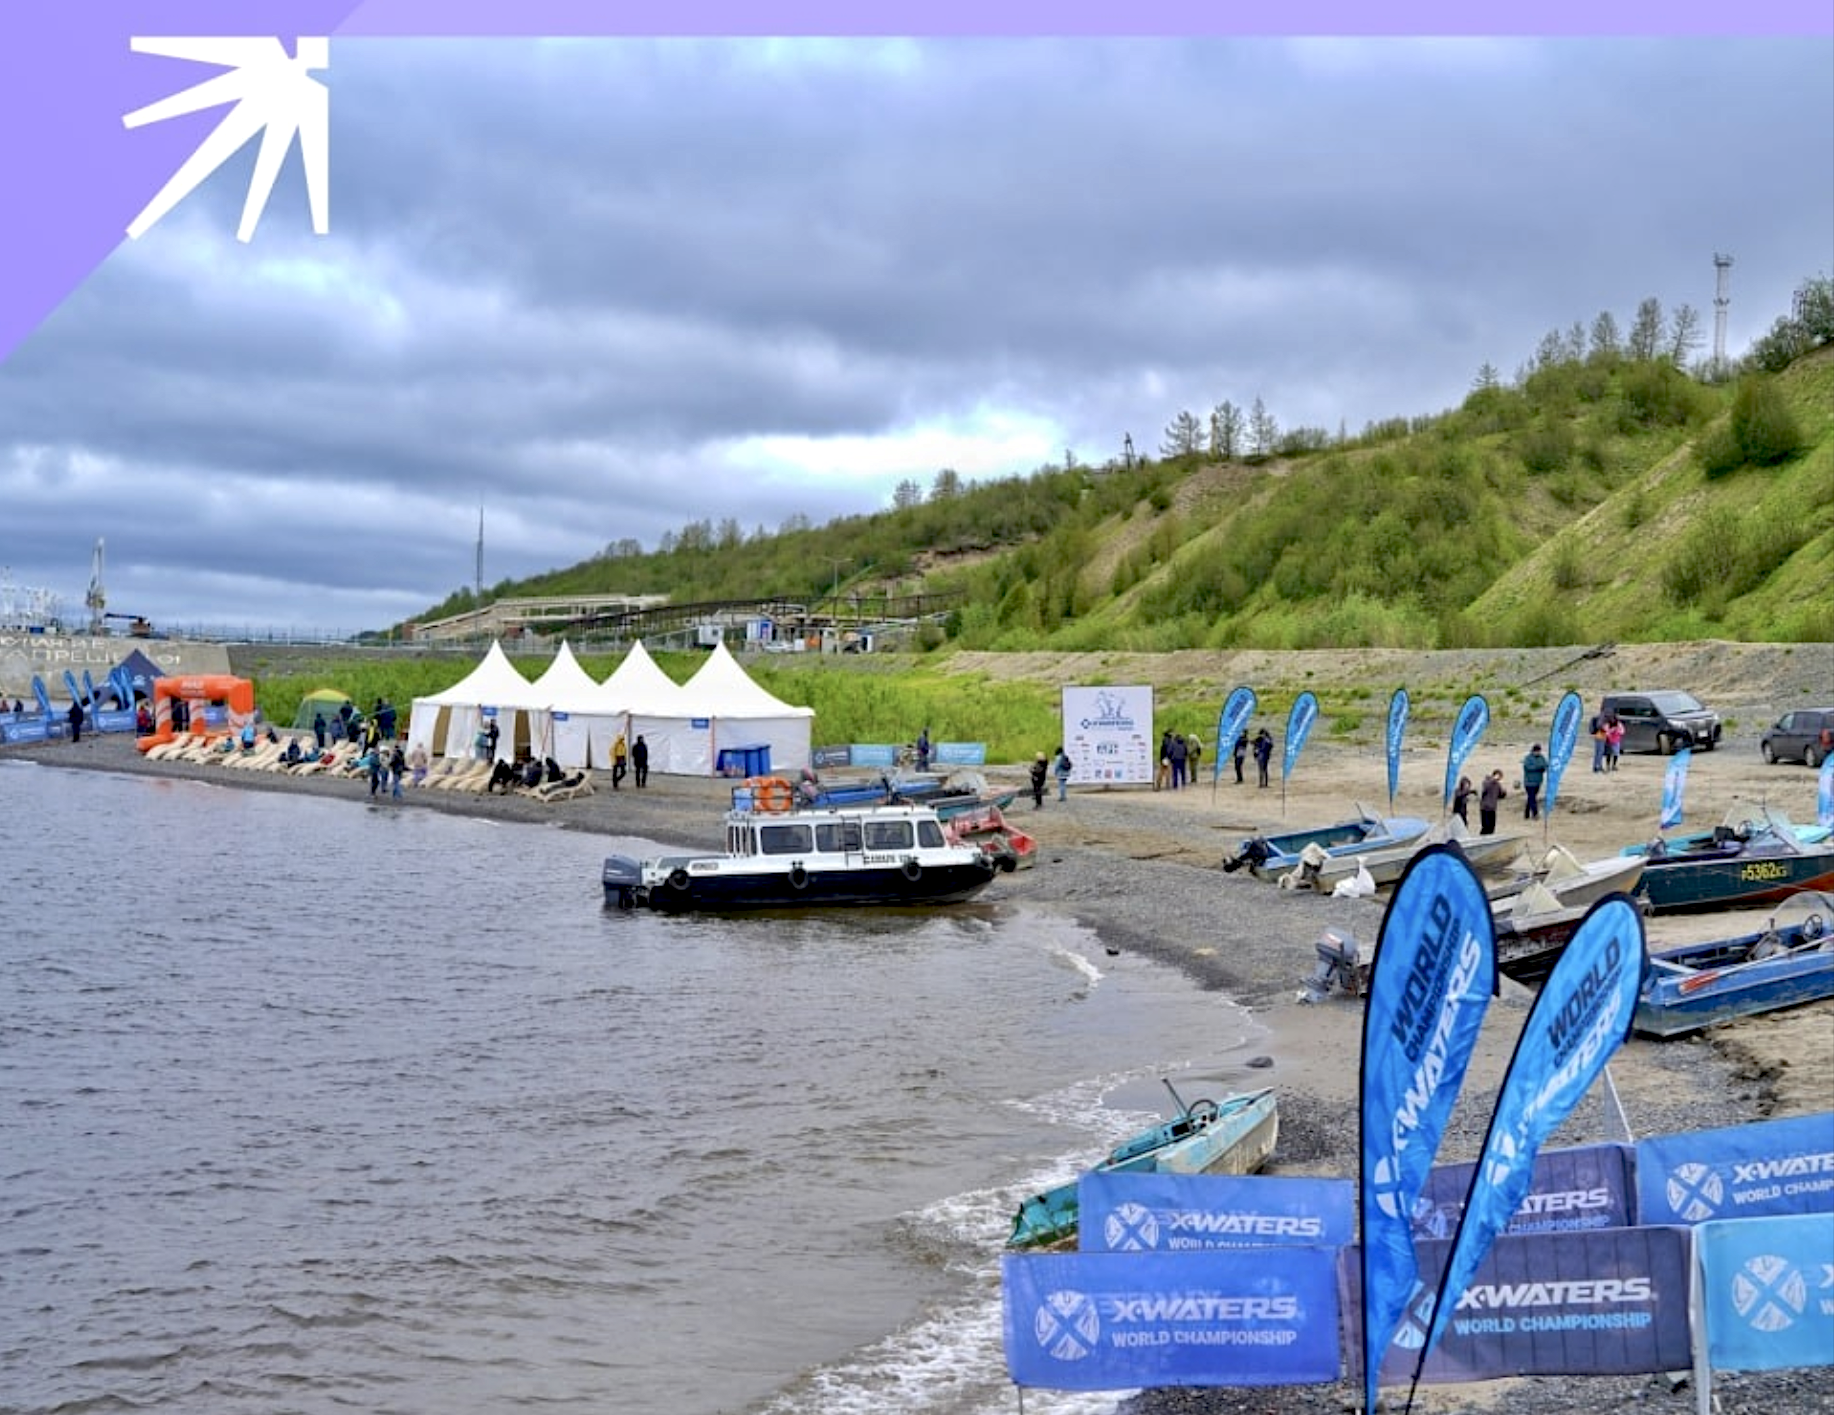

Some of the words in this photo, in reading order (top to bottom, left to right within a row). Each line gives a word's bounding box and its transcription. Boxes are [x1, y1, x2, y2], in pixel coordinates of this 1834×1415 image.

[1390, 893, 1452, 1046] WORLD
[1548, 936, 1621, 1049] WORLD
[1731, 1184, 1781, 1205] WORLD
[1454, 1317, 1516, 1335] WORLD
[1519, 1311, 1652, 1333] CHAMPIONSHIP
[1112, 1331, 1170, 1348] WORLD
[1173, 1330, 1297, 1346] CHAMPIONSHIP
